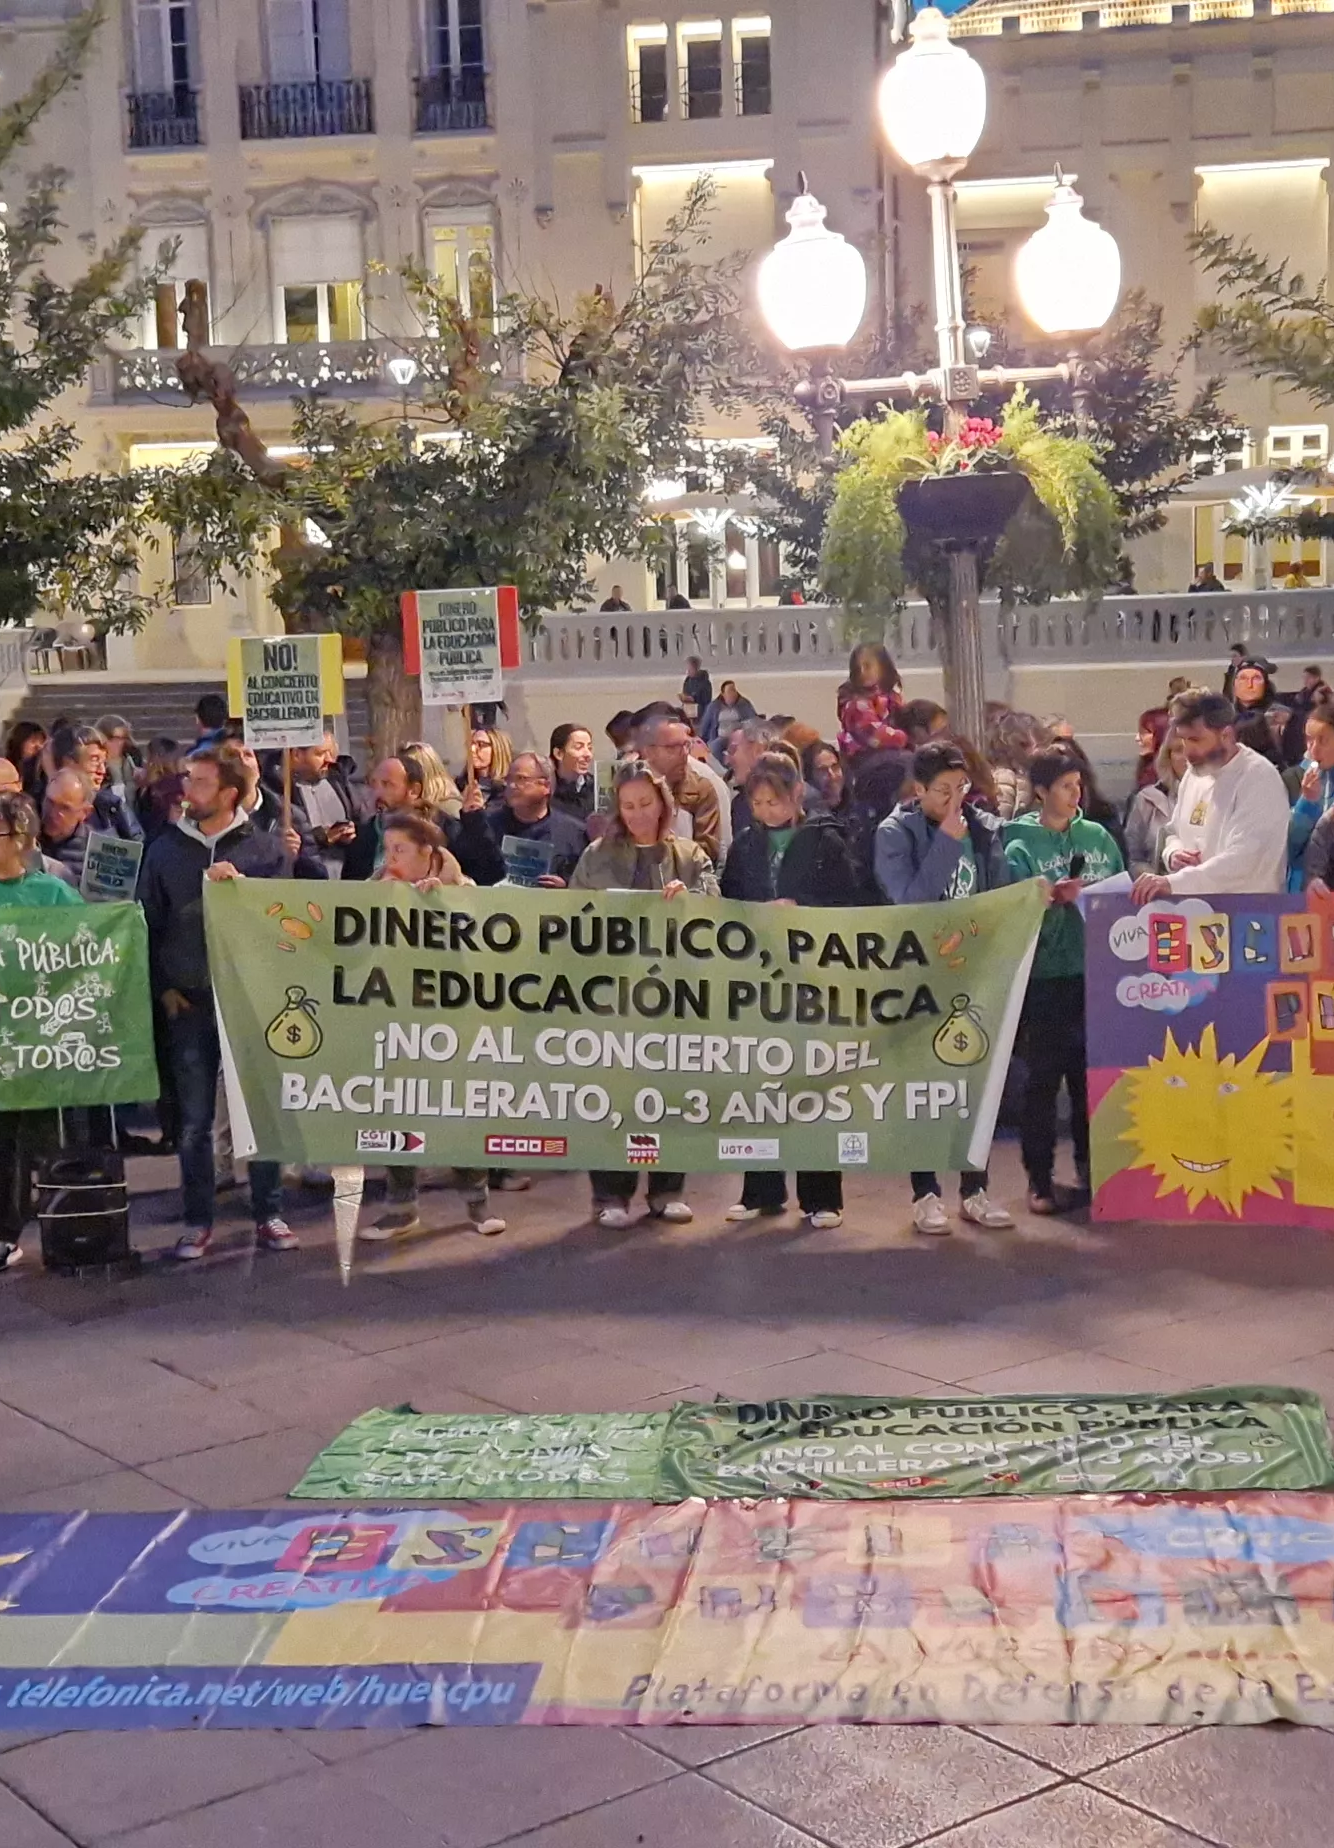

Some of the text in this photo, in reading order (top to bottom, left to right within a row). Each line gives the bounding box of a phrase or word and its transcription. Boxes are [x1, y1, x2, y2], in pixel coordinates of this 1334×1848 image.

[263, 643, 299, 671] NO!
[333, 901, 930, 971] DINERO PÚBLICO, PARA
[1113, 925, 1149, 948] VIVA
[16, 932, 121, 975] PÚBLICA:
[333, 963, 941, 1027] LA EDUCACIÓN PÚBLICA
[12, 1044, 122, 1072] TOD@S
[374, 1021, 880, 1077] ¡NO AL CONCIERTO DEL
[281, 1071, 971, 1130] BACHILLERATO, 0-3 AÑOS Y FP!
[488, 1138, 542, 1152] CCOO
[721, 1145, 743, 1155] UGT
[1126, 1402, 1250, 1416] PARA
[798, 1418, 1065, 1439] EDUCACIÓN
[844, 1443, 895, 1457] AL
[1167, 1671, 1215, 1702] de
